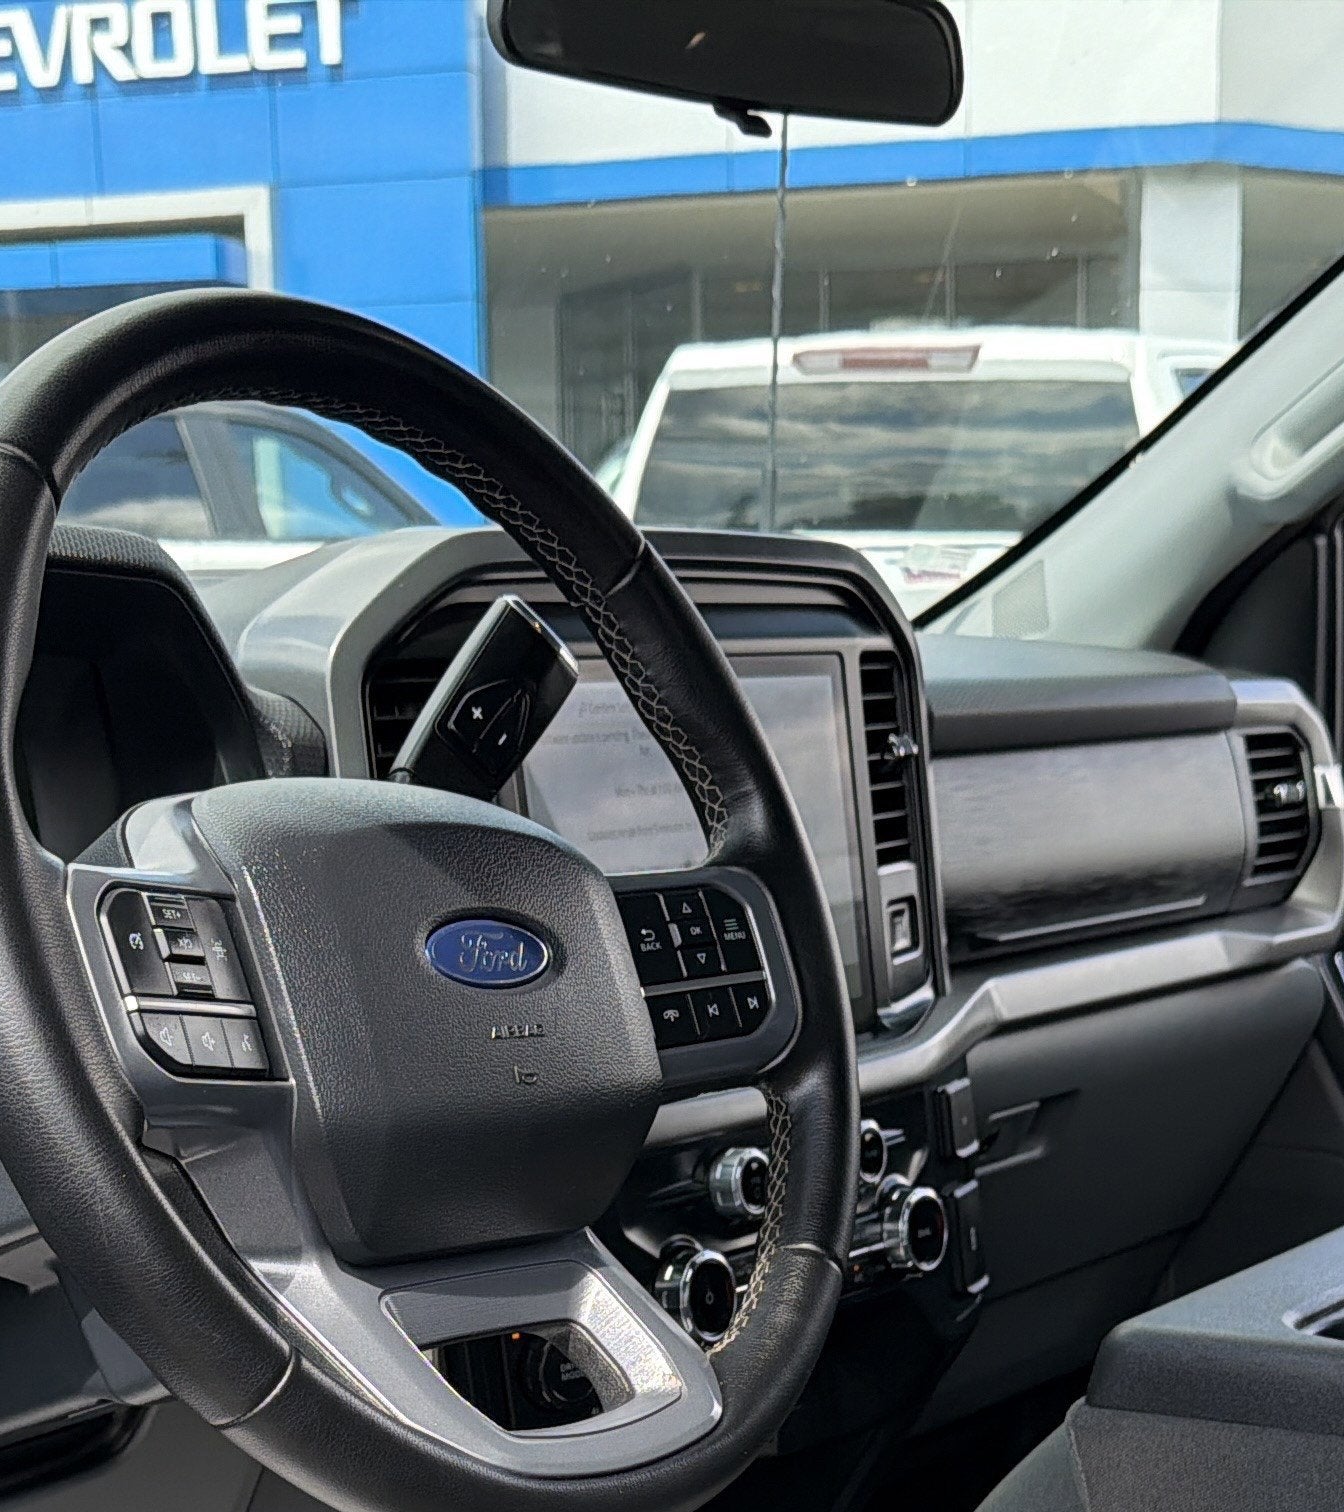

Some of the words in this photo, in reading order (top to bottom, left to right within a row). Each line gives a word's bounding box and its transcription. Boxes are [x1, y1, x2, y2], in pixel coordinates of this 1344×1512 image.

[689, 926, 703, 935] OK
[723, 929, 746, 942] MENU
[458, 930, 528, 973] Ford
[640, 939, 663, 952] BACK
